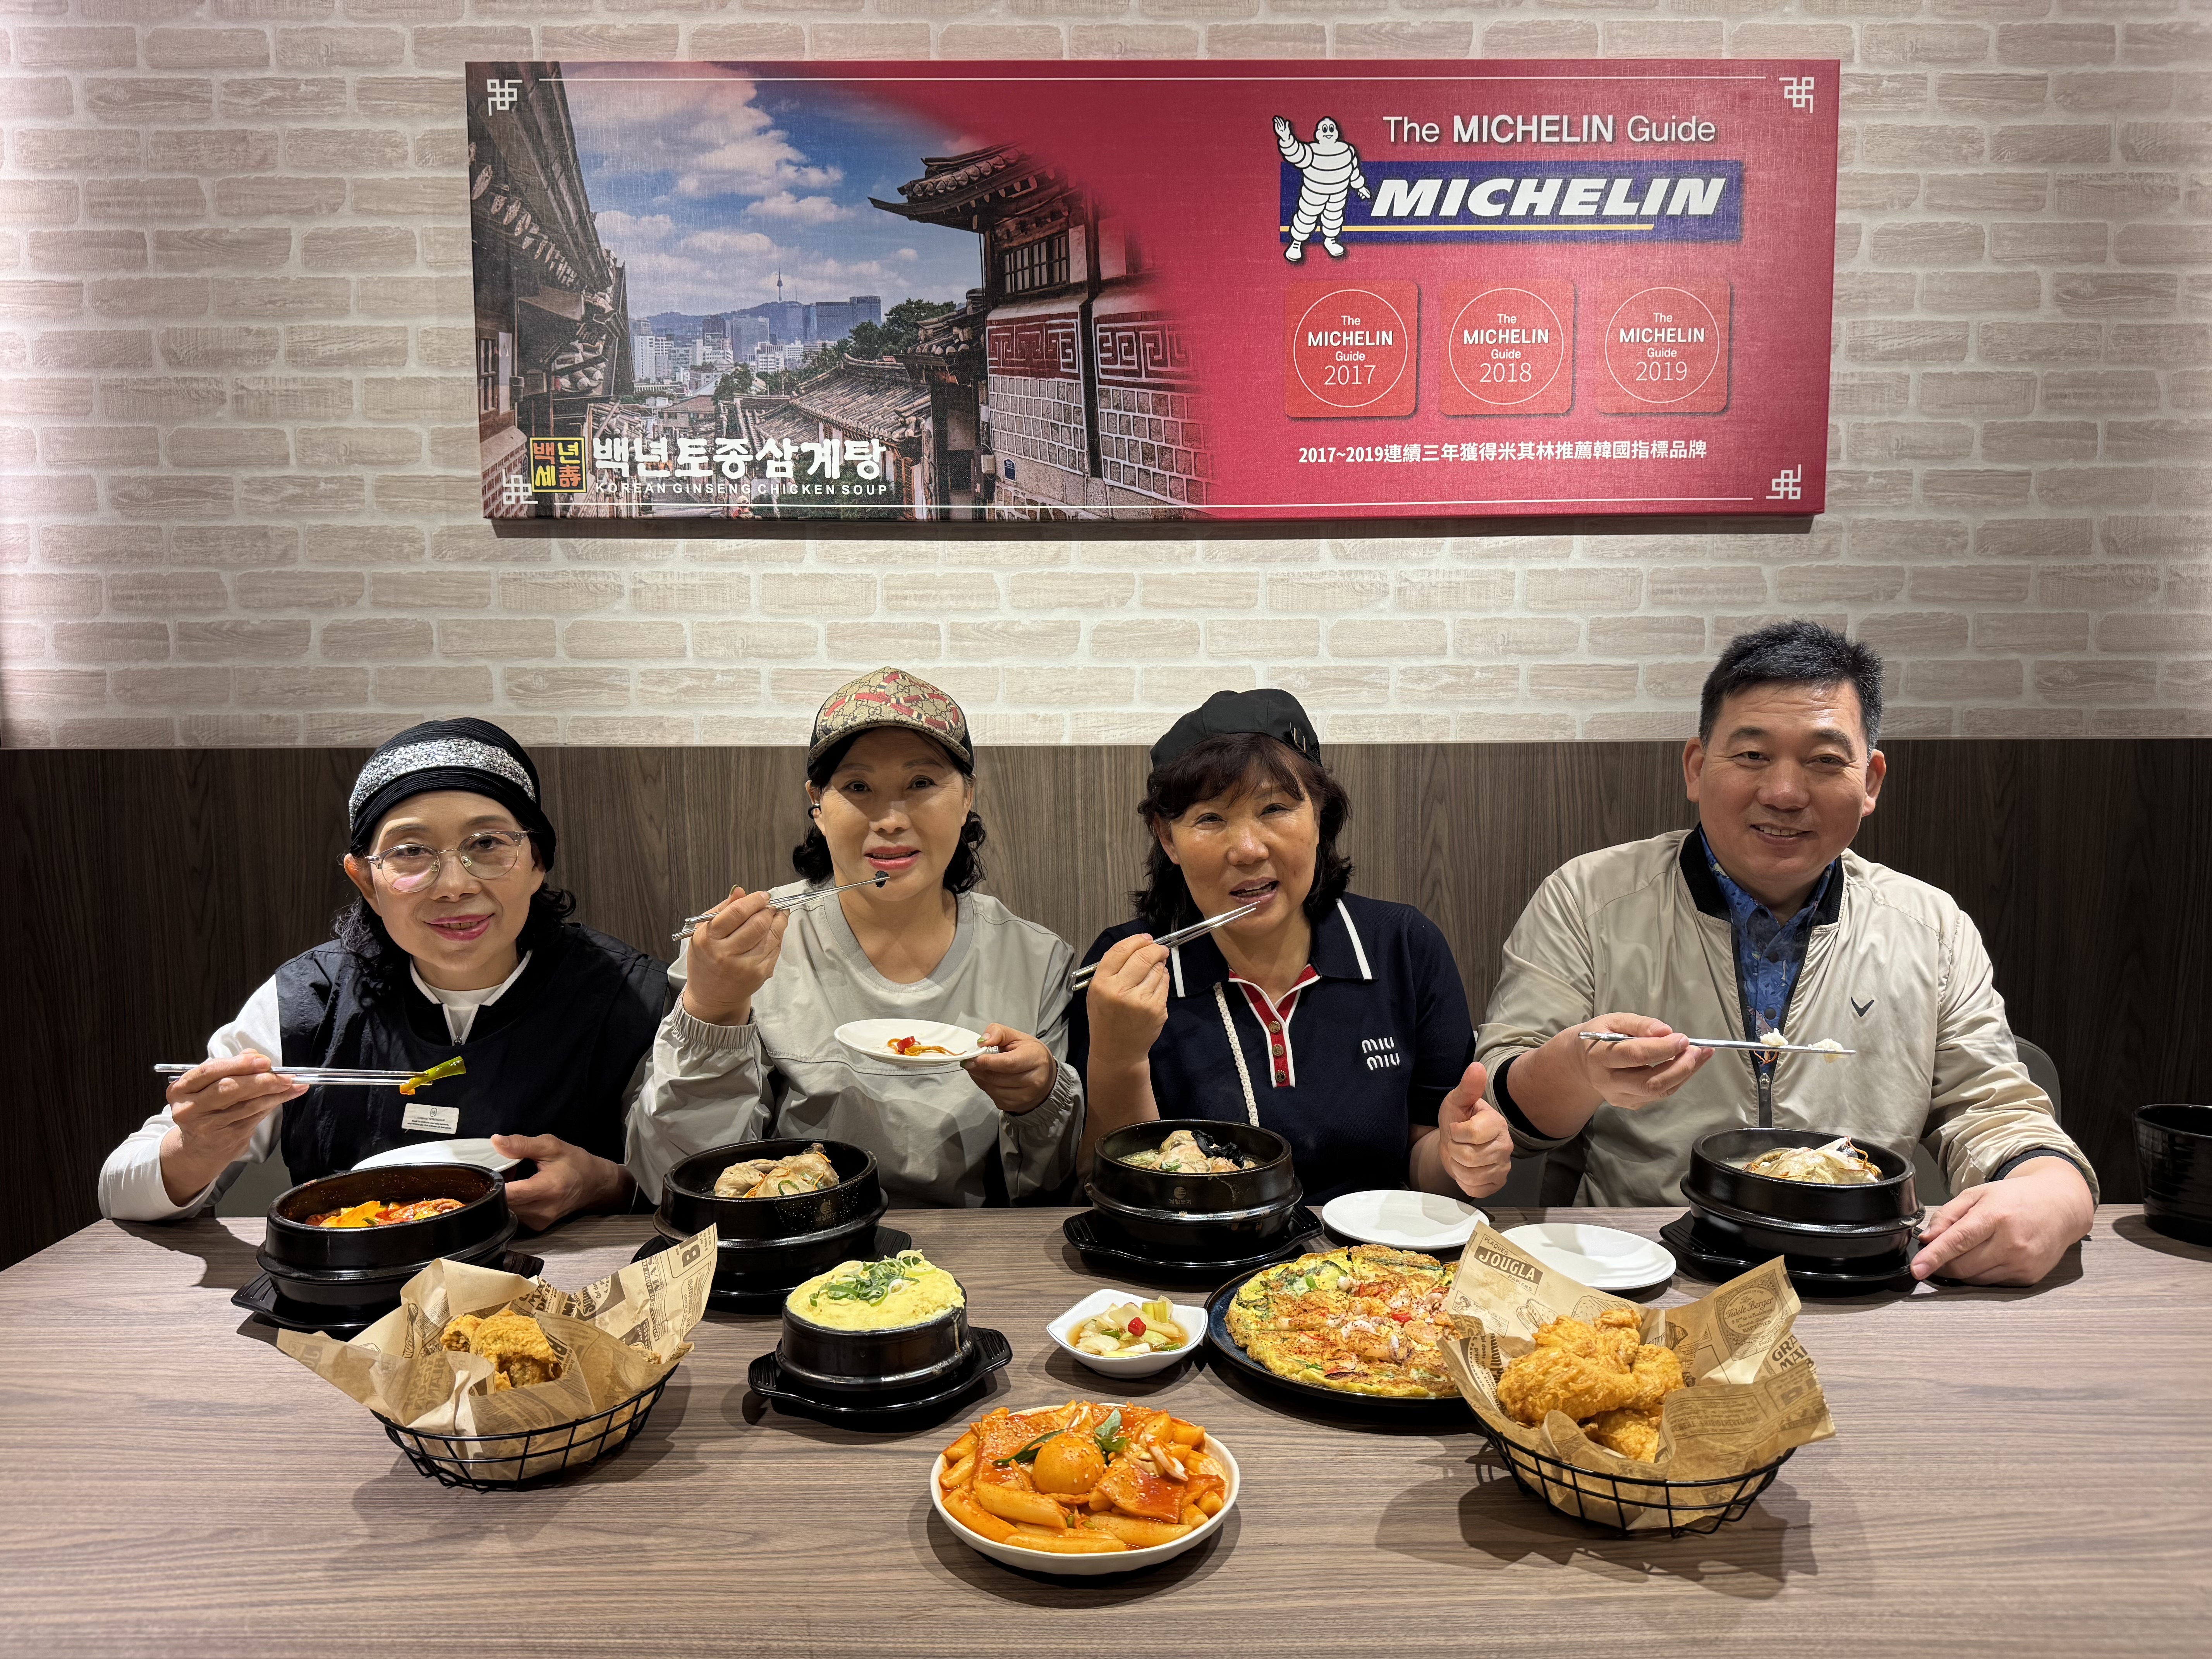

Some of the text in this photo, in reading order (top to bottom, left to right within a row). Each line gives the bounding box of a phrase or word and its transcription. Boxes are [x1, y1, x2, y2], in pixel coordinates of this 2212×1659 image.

[1382, 115, 1716, 143] The MICHELIN Guide
[1370, 178, 1726, 217] MICHELIN
[1341, 315, 1361, 326] The
[1497, 313, 1517, 324] The
[1653, 312, 1673, 323] The
[1308, 330, 1393, 347] MICHELIN
[1463, 328, 1549, 344] MICHELIN
[1620, 328, 1704, 343] MICHELIN
[1335, 350, 1365, 361] Guide
[1491, 349, 1521, 359] Guide
[1647, 347, 1677, 358] Guide
[1324, 365, 1376, 385] 2017
[1480, 362, 1532, 383] 2018
[1635, 361, 1687, 381] 2019
[593, 437, 886, 480] 백년토종삼계탕
[1298, 440, 1707, 463] 2017~2019連續三年獲得米其林推薦韓國指標品牌
[596, 483, 887, 495] KOREAN GINSENG CHICKEN SOUP
[1484, 1237, 1508, 1255] PLAQUES
[1479, 1251, 1535, 1281] JOUGLA
[1508, 1274, 1532, 1291] PAPIERS
[1747, 1297, 1774, 1311] Berger
